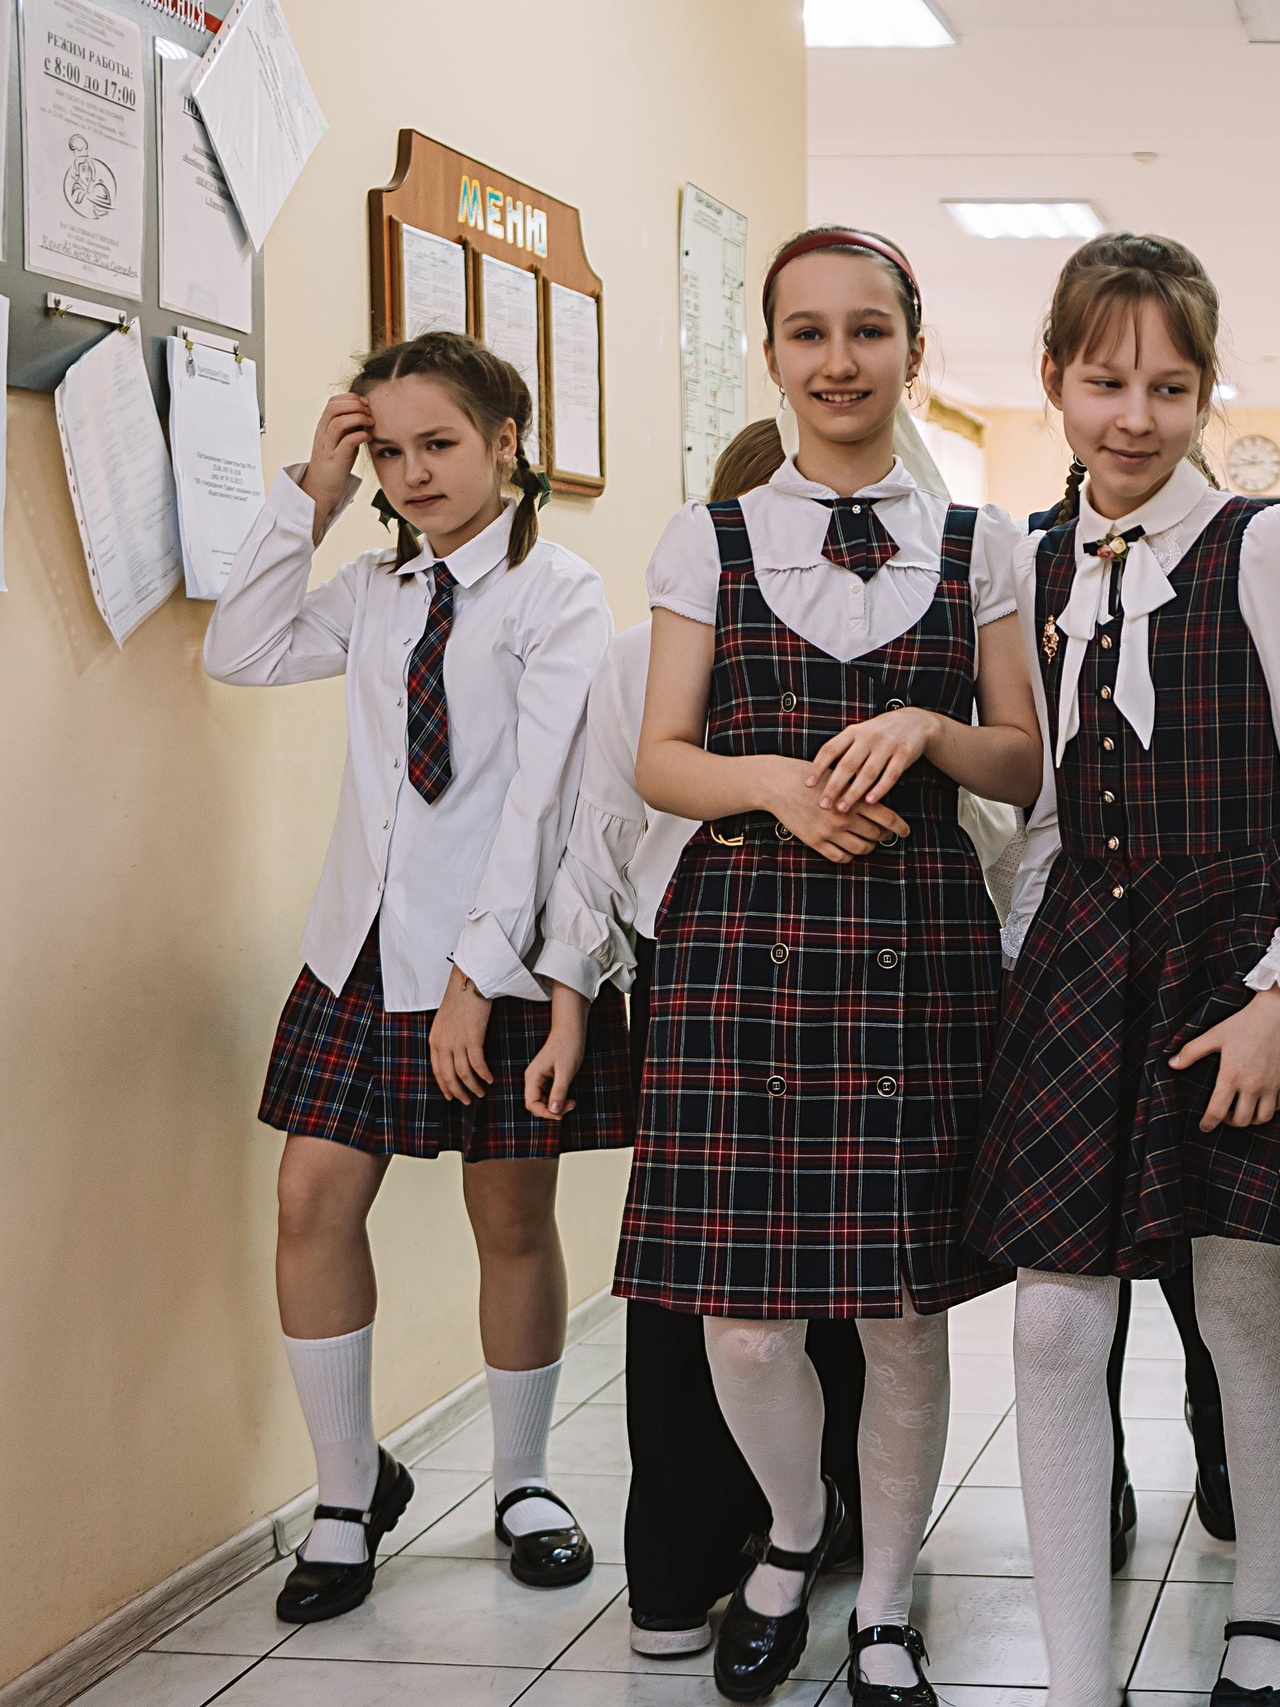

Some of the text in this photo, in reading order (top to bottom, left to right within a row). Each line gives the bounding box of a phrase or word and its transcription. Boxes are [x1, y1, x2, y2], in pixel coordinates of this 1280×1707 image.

[47, 31, 86, 60] РЕЖИМ
[89, 50, 134, 80] РАБОТЫ:
[44, 57, 51, 71] с
[54, 56, 81, 84] 8:00
[83, 75, 100, 92] до
[104, 78, 136, 107] 17:00
[457, 174, 548, 260] МЕНЮ
